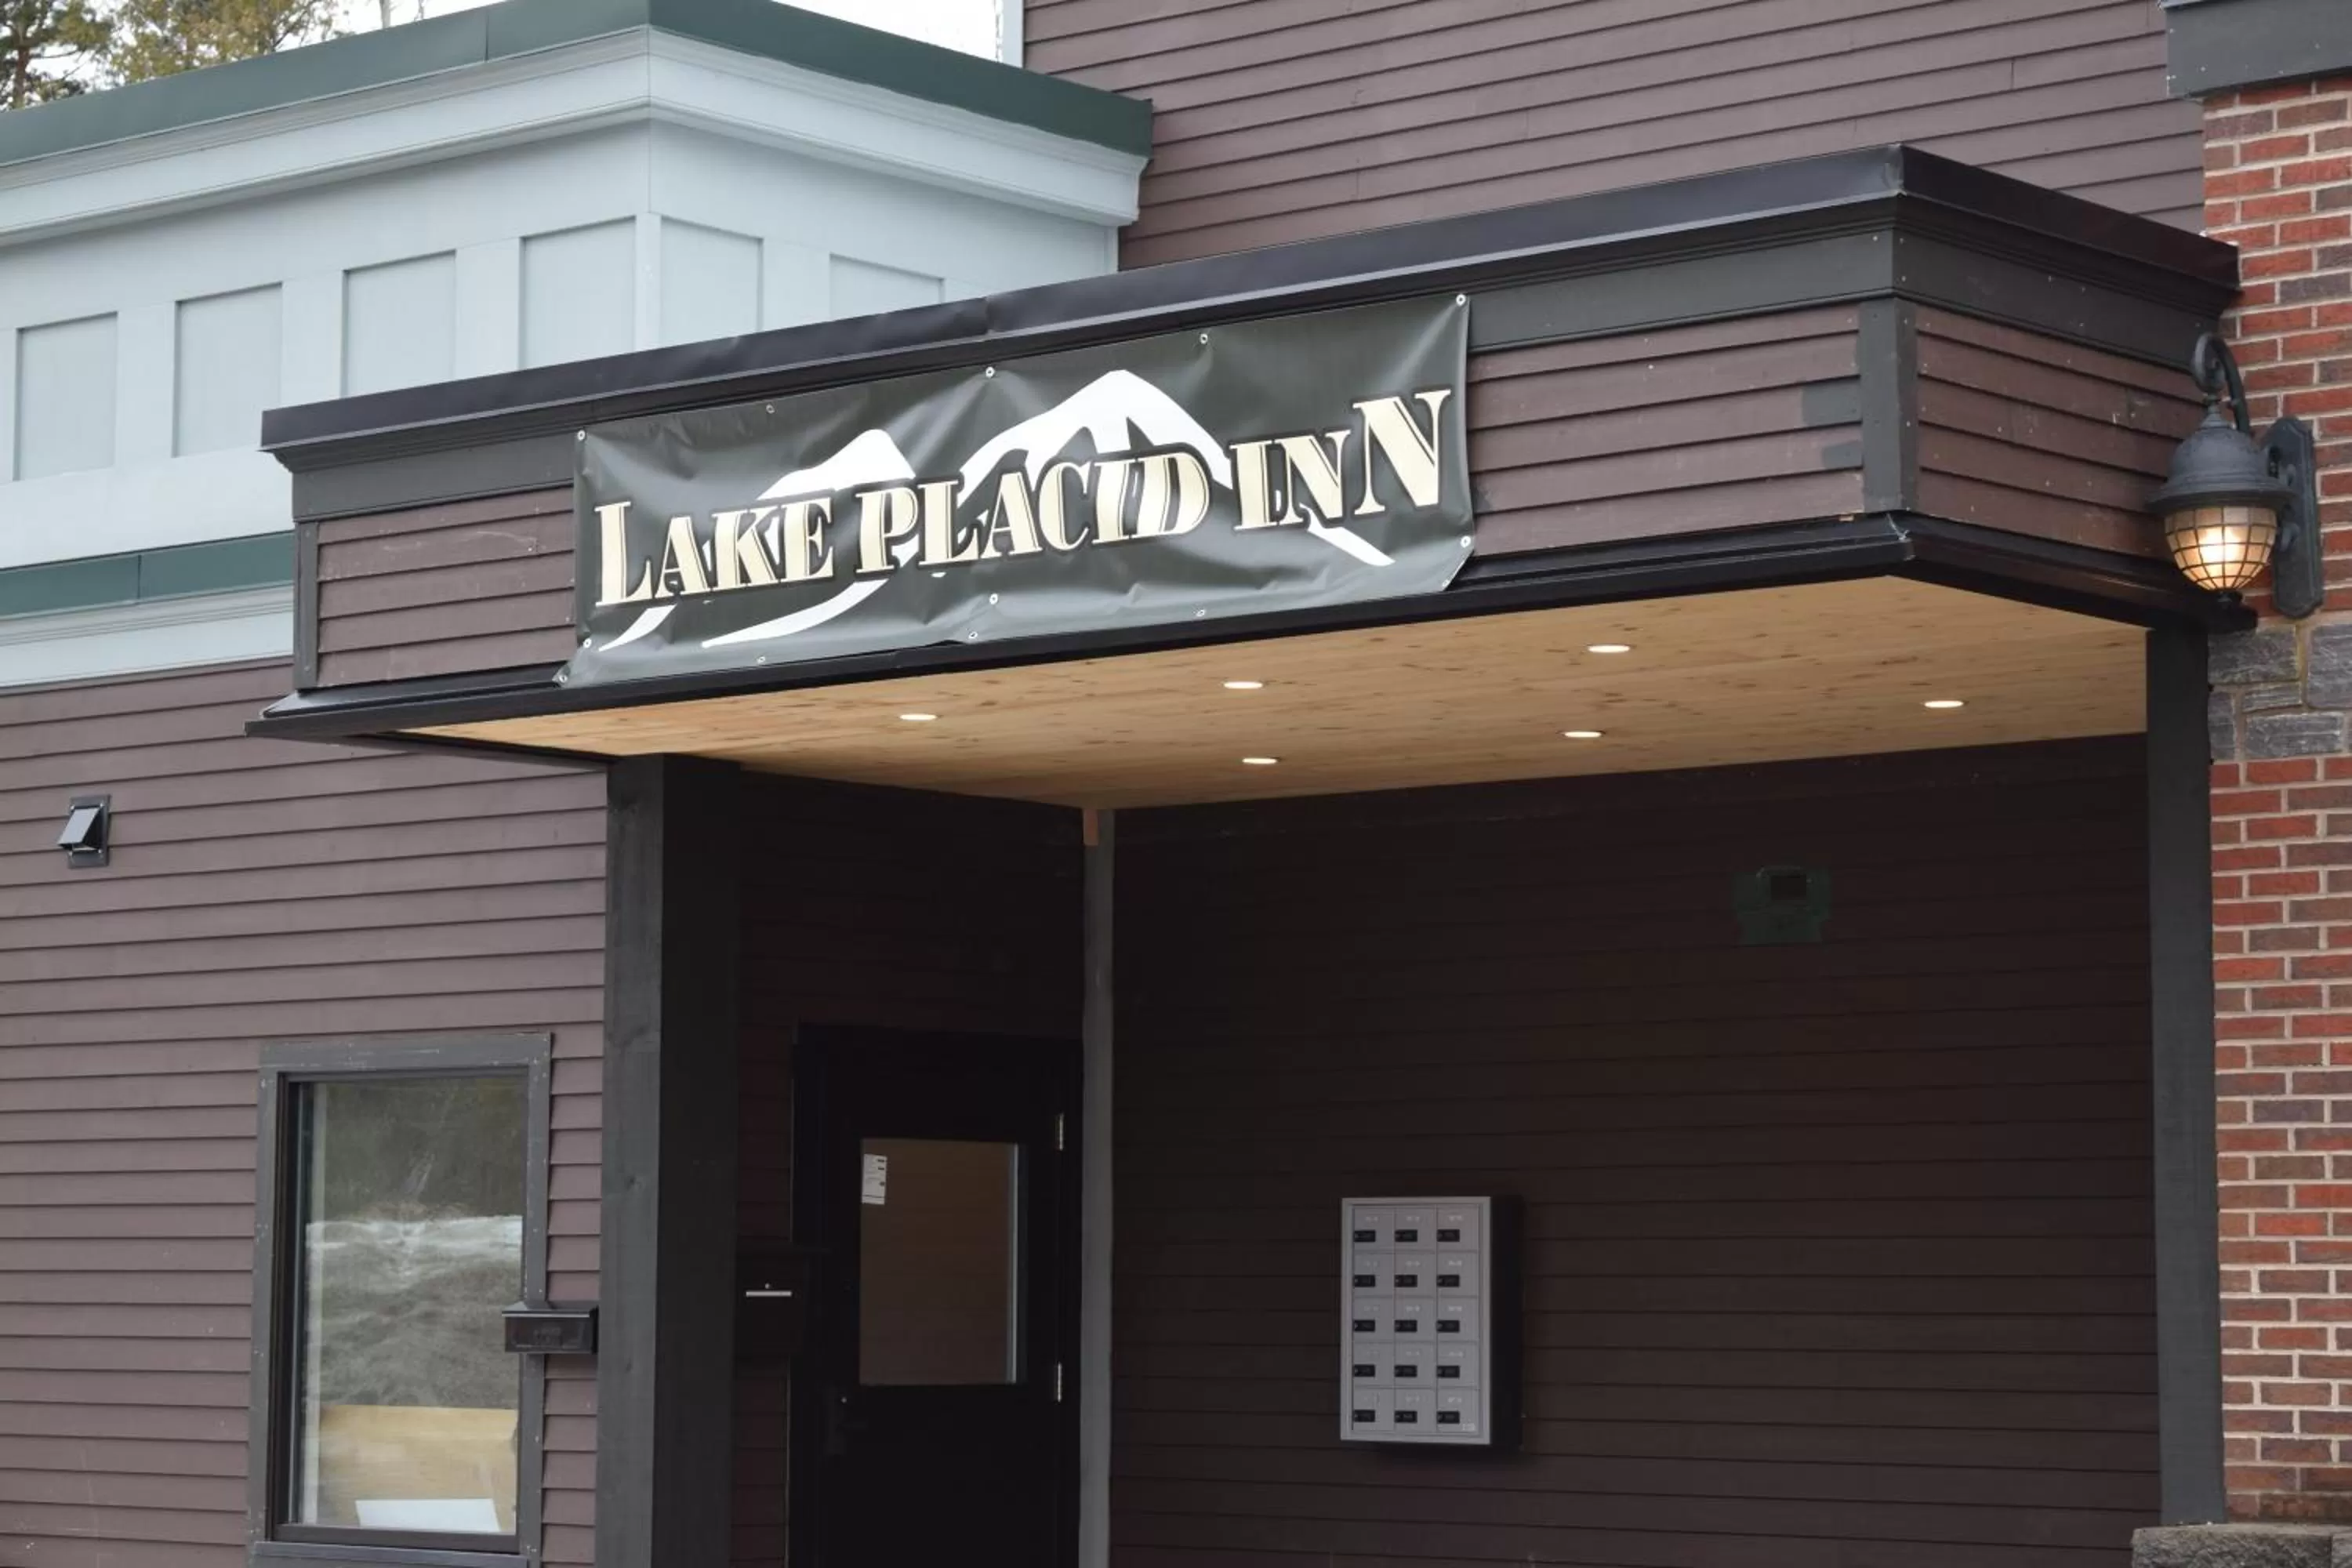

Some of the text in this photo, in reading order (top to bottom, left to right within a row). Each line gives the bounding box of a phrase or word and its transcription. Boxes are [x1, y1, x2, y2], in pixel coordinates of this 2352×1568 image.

[594, 390, 1451, 607] LAKE PLACID INN
